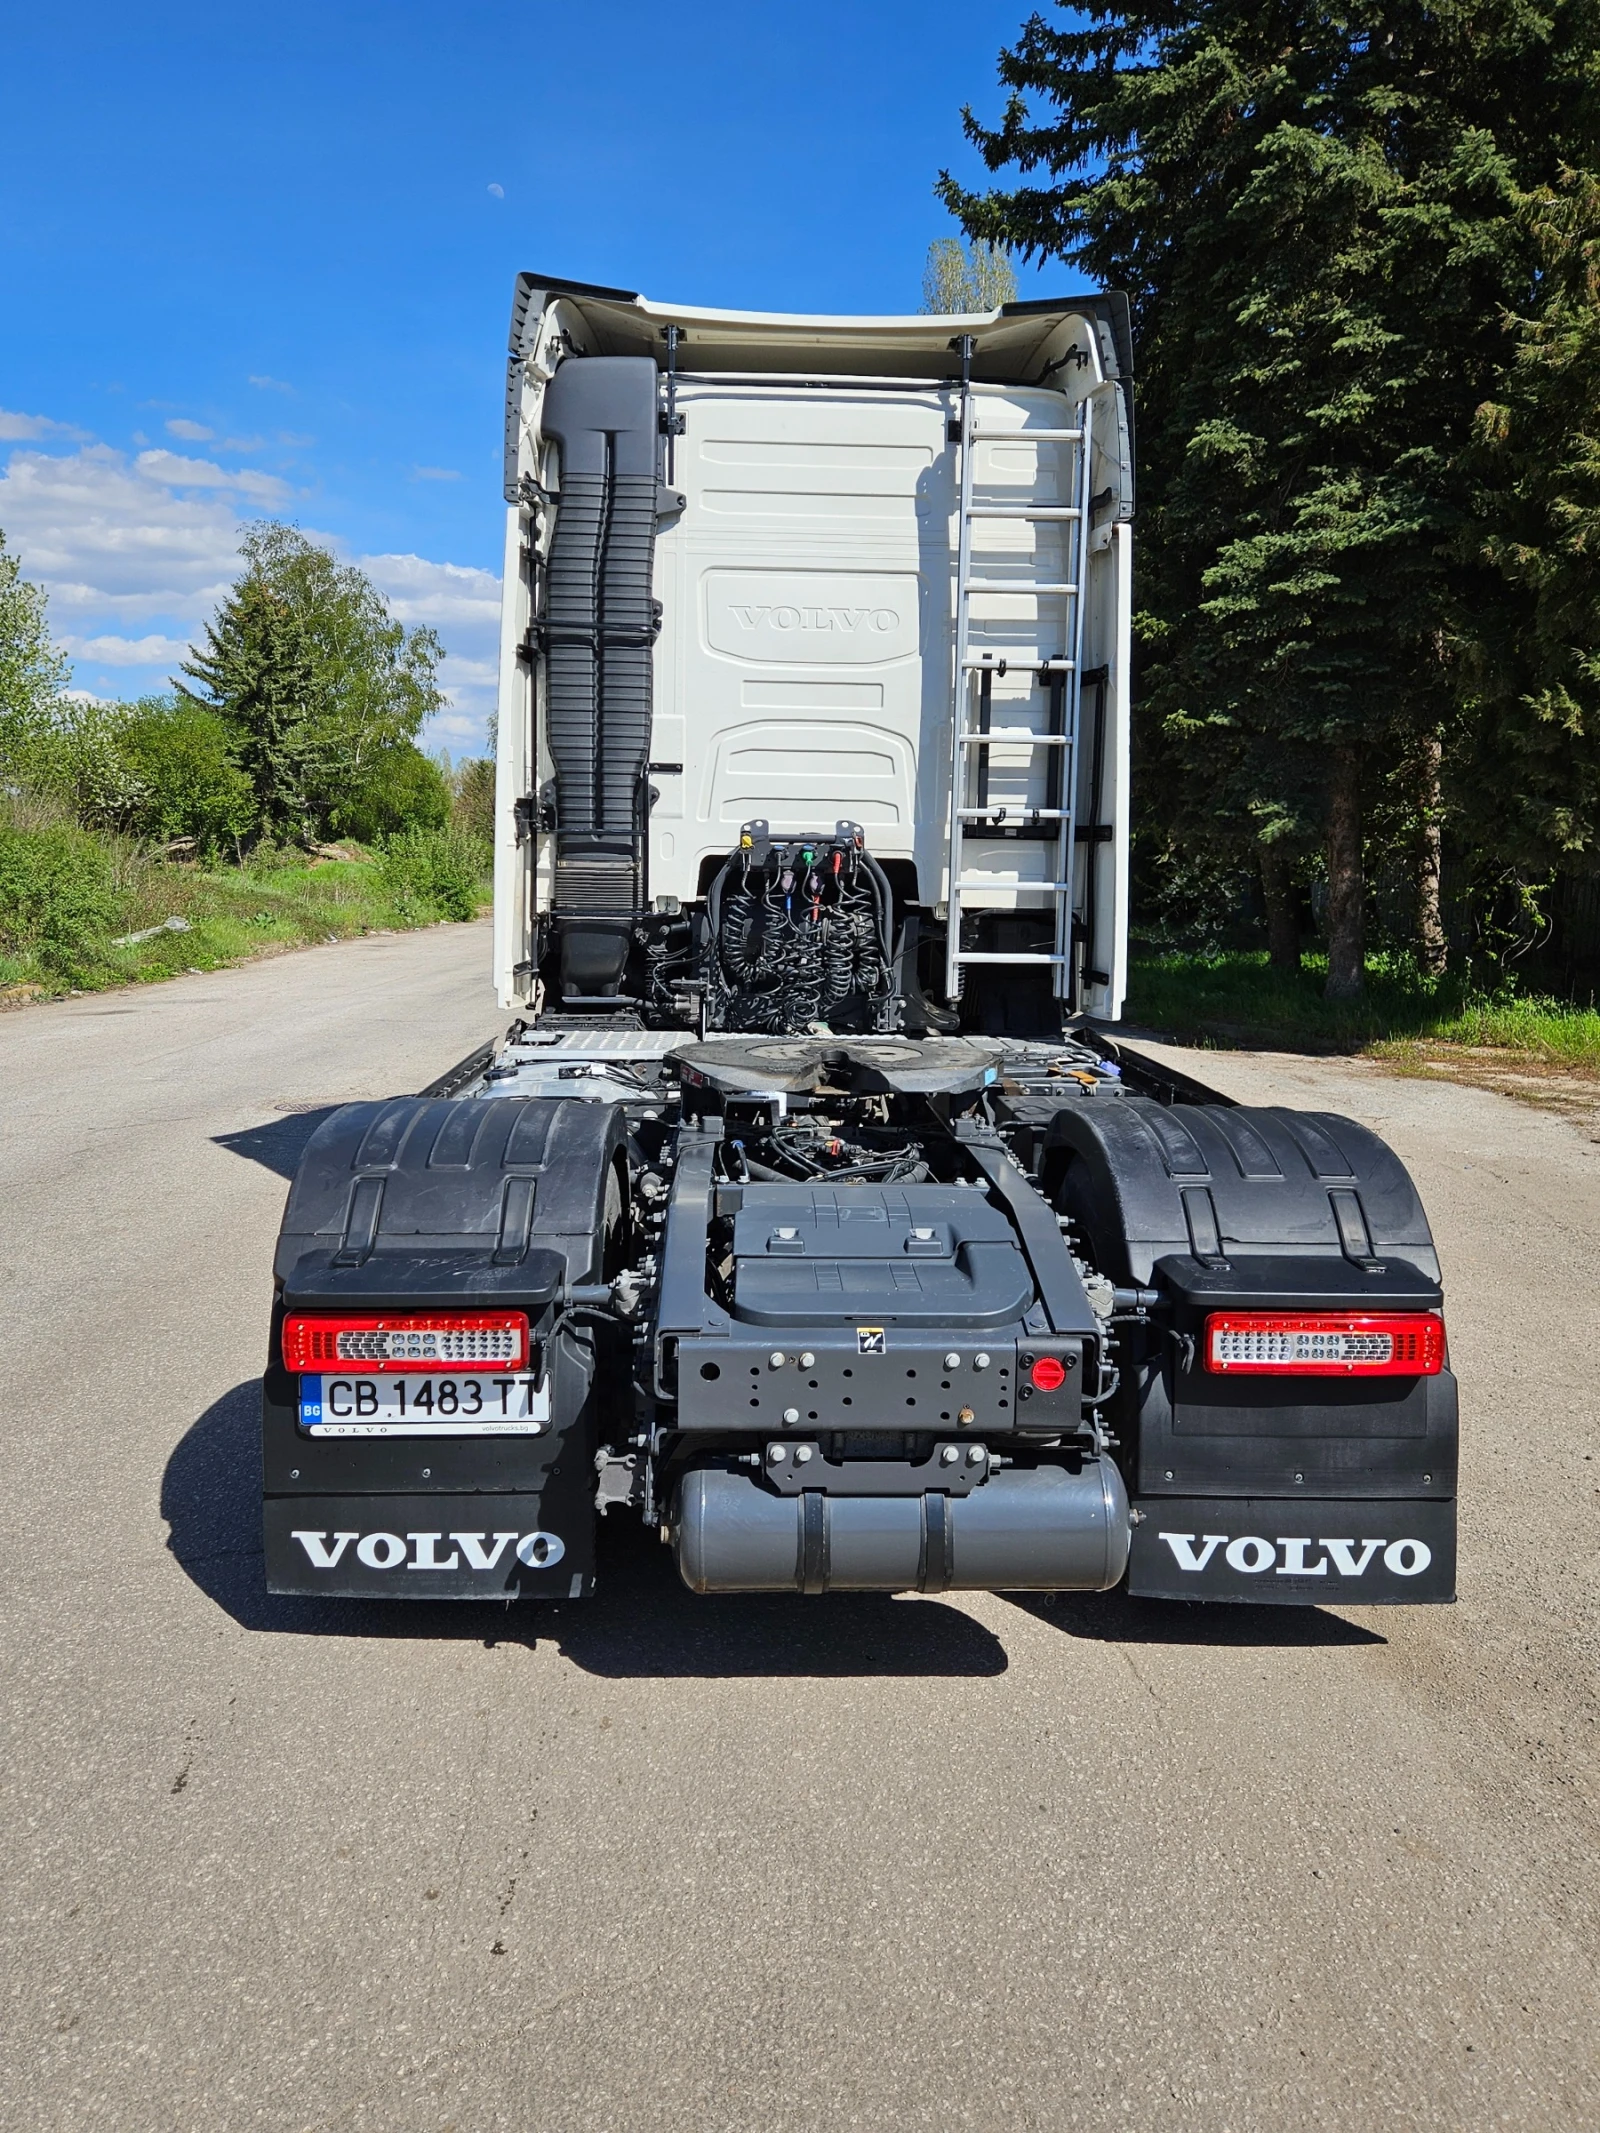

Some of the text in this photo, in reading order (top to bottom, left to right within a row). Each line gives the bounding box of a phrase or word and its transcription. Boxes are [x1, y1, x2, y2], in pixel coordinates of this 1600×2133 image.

[728, 605, 900, 633] VOLVO
[303, 1405, 320, 1416] BG
[329, 1380, 379, 1416] CB
[393, 1379, 483, 1416] 1483
[291, 1531, 565, 1569] VOLVO
[1158, 1532, 1432, 1576] VOLVO
